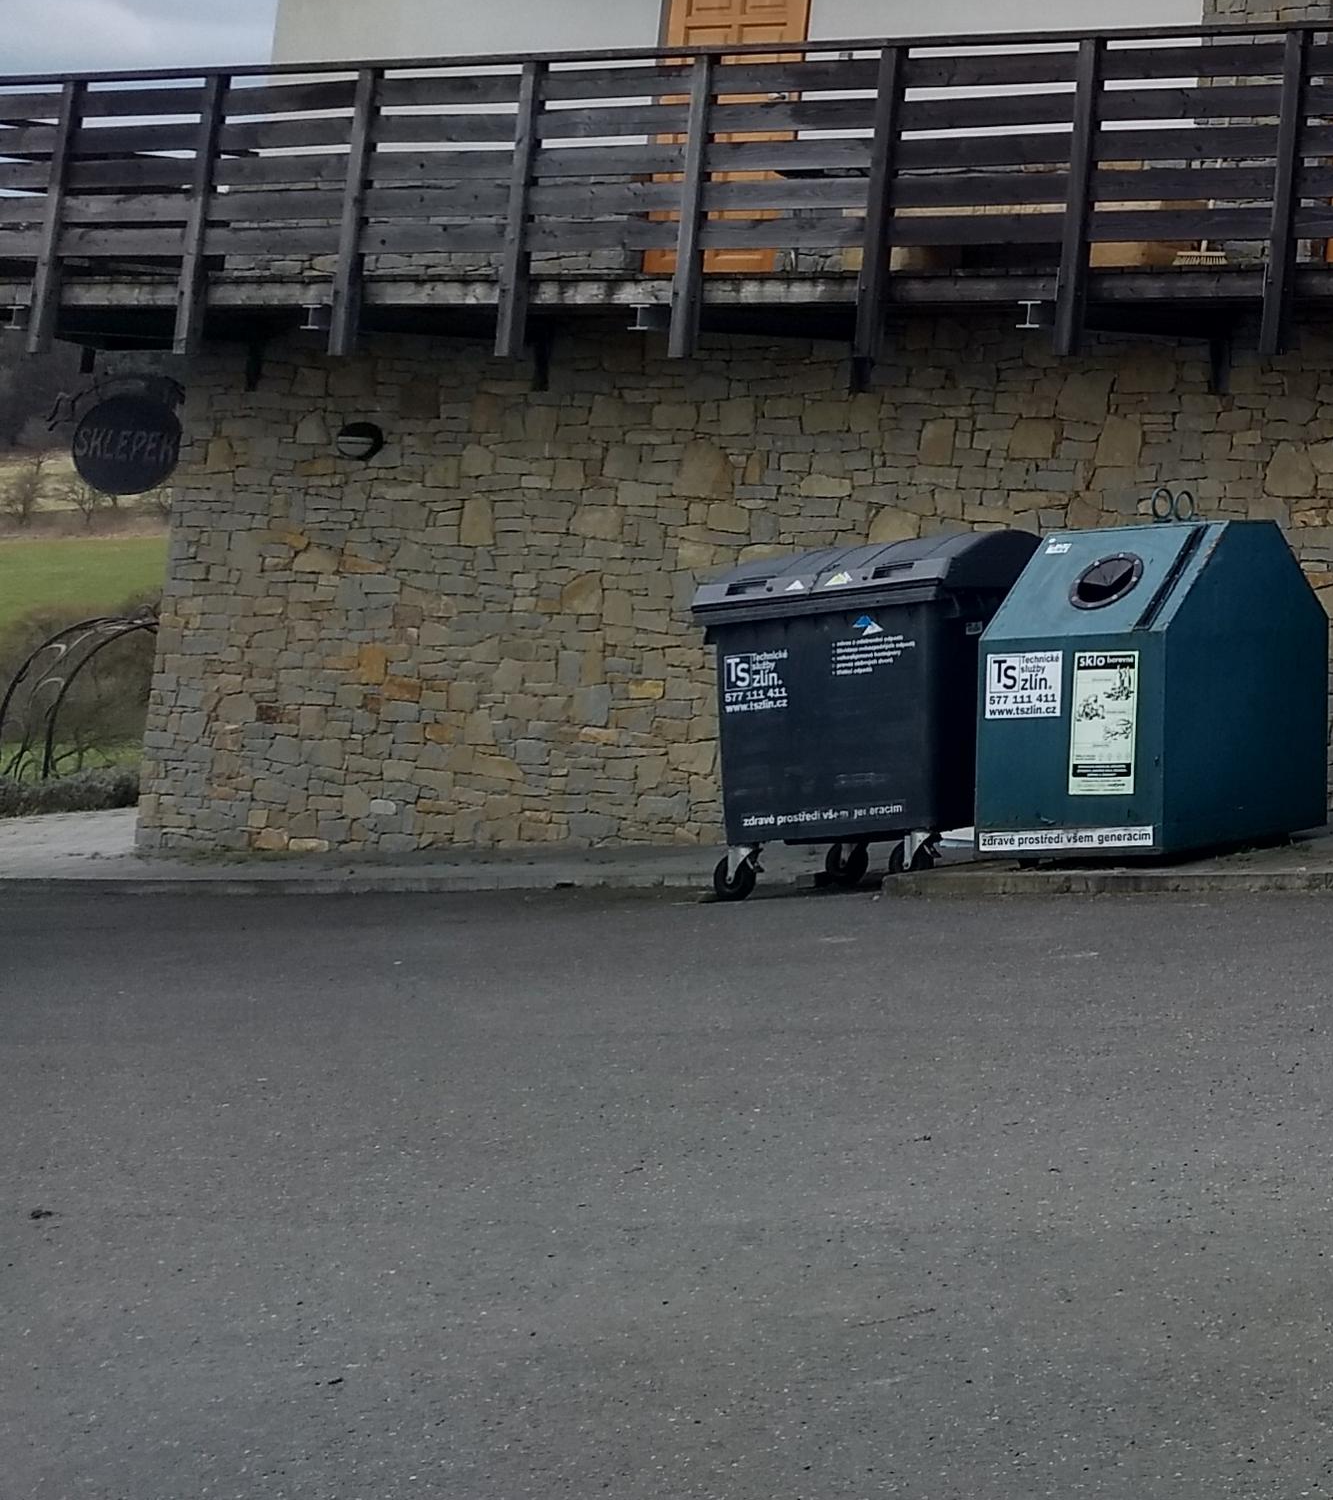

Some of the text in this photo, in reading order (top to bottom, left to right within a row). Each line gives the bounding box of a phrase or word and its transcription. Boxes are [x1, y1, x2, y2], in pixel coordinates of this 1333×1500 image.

[1021, 653, 1060, 664] Technické
[1079, 654, 1106, 667] sklo
[726, 657, 750, 687] TS
[992, 659, 1018, 690] TS
[725, 687, 789, 703] 577 111 411
[988, 693, 1057, 706] 577 111 411
[981, 835, 1015, 847] zdravé
[1066, 833, 1094, 844] všem
